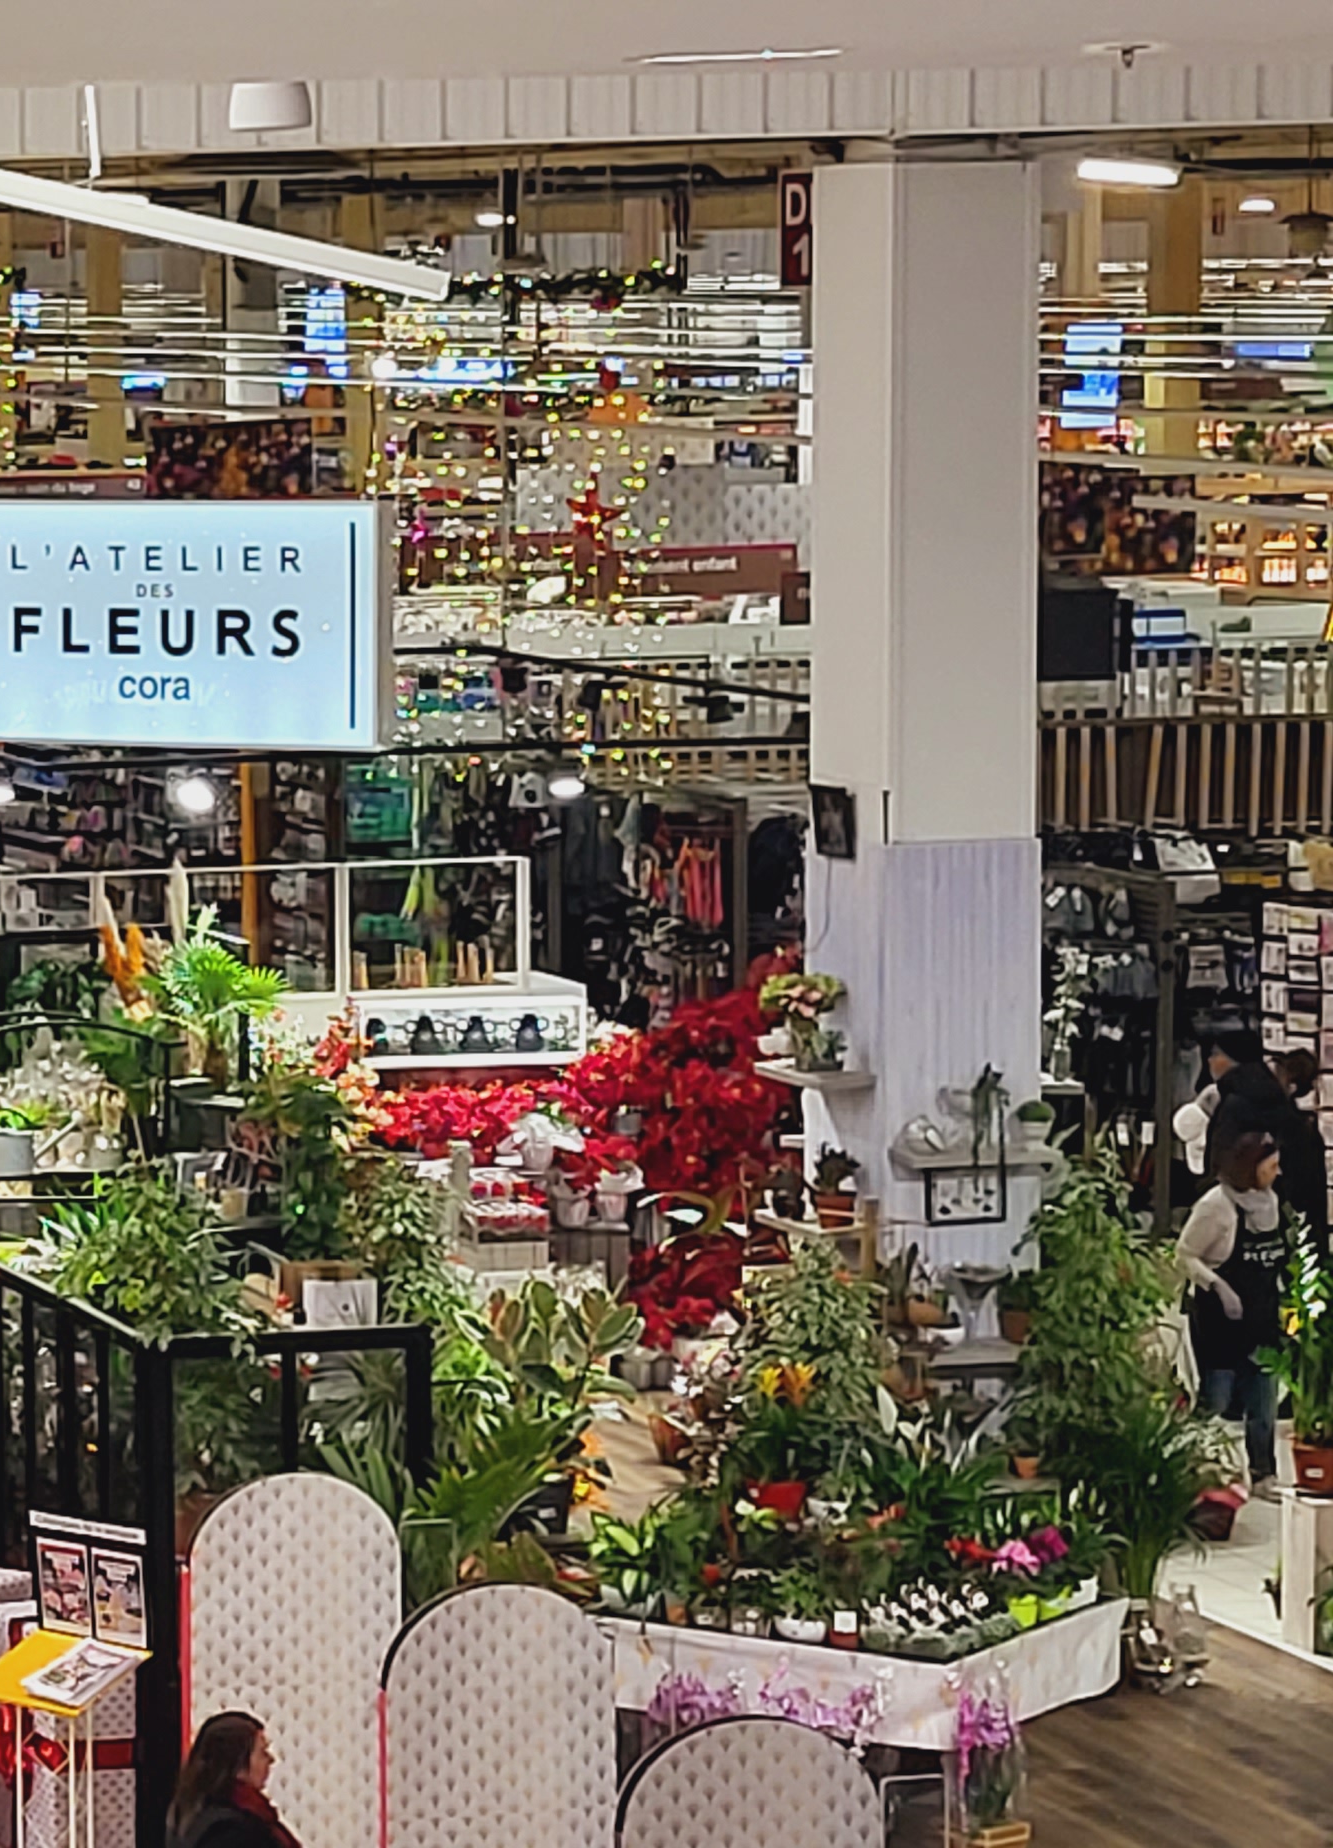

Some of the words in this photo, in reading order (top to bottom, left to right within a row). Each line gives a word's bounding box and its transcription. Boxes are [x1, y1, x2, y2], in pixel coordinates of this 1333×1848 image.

[785, 183, 813, 225] D
[10, 544, 302, 573] L'ATELIER
[135, 583, 174, 598] DES
[12, 606, 301, 658] FLEURS
[117, 674, 191, 701] cora
